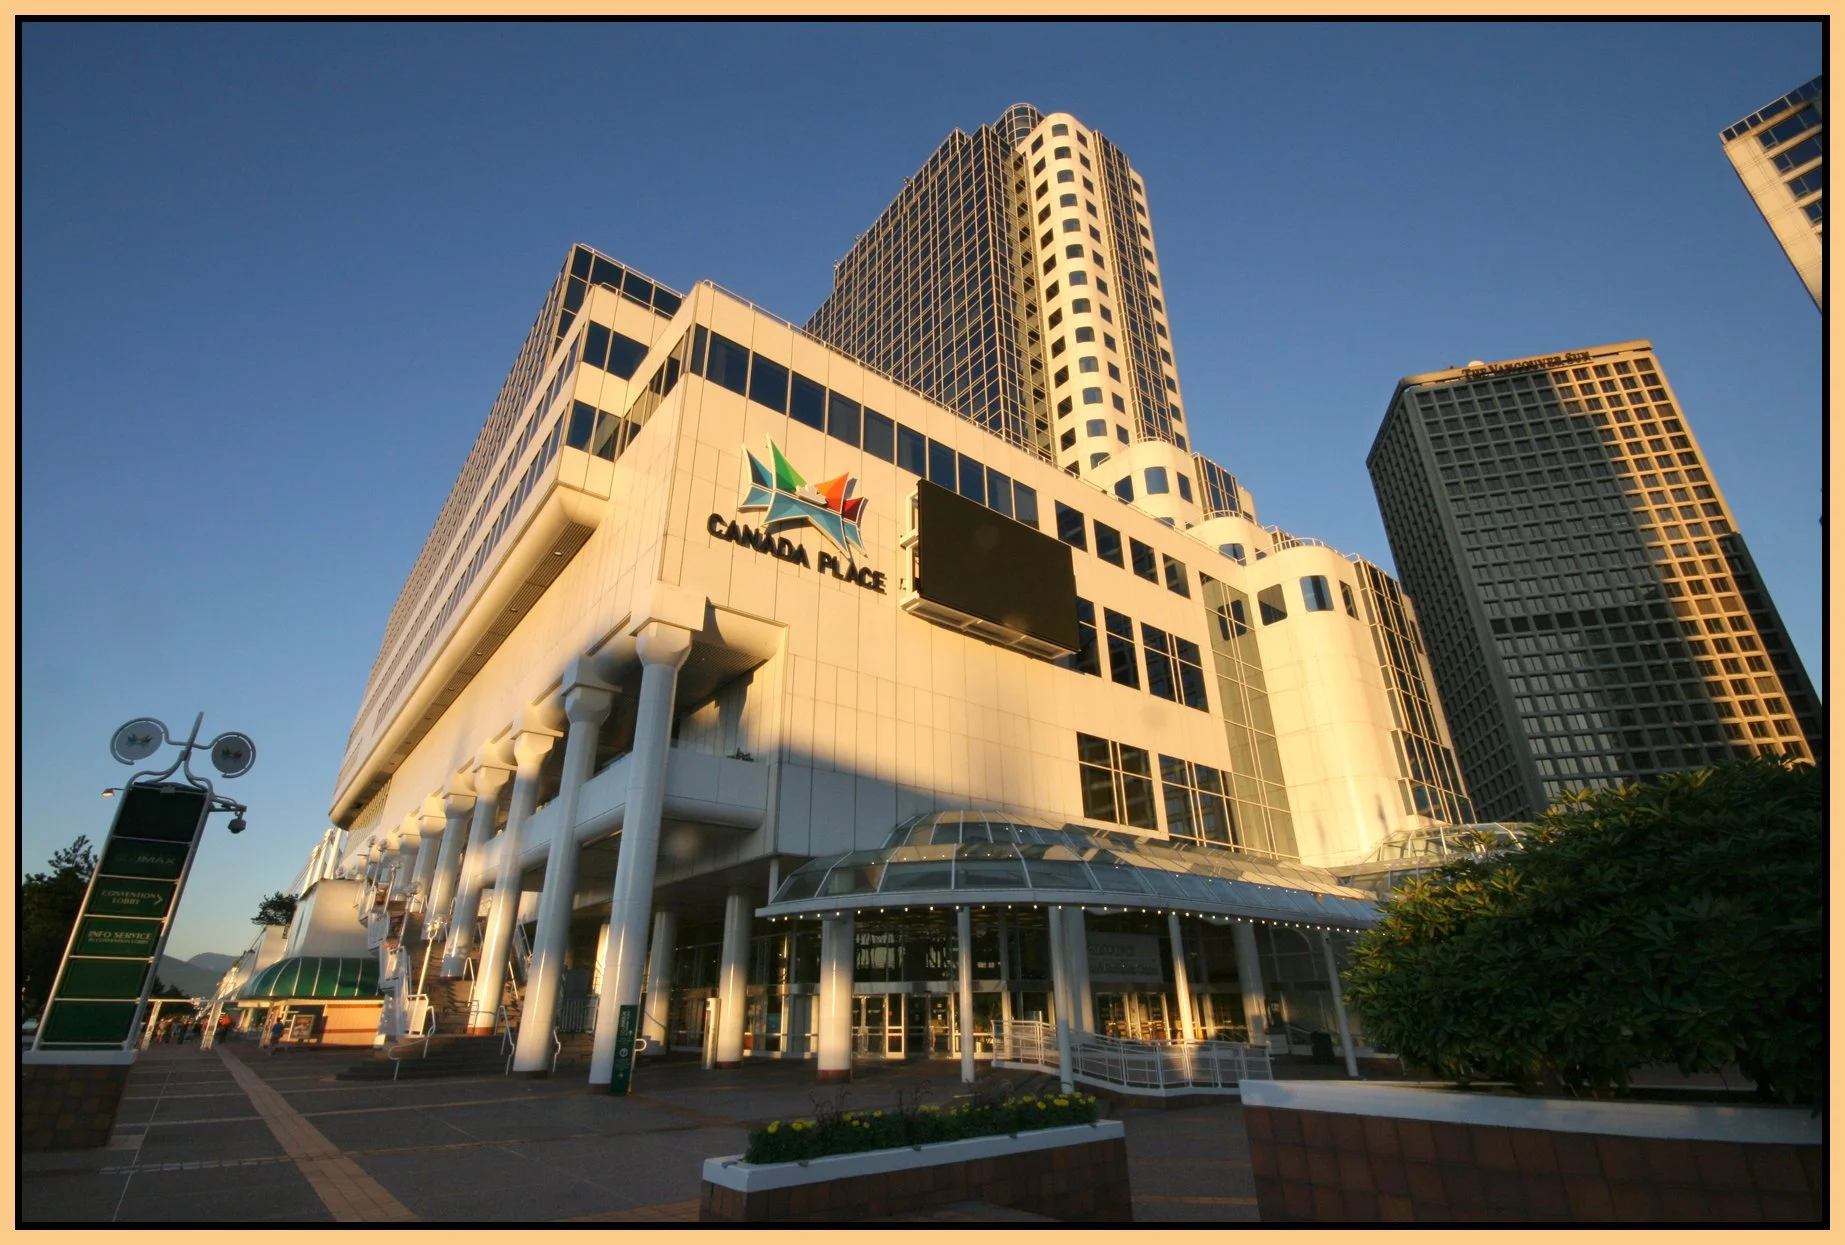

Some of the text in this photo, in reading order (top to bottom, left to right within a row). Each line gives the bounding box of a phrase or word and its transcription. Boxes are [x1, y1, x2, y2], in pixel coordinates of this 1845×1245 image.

[706, 513, 887, 595] CANADA PLACE
[136, 855, 176, 865] IMAX
[101, 890, 156, 899] CONVENTION
[88, 930, 152, 940] INFO SERVICE
